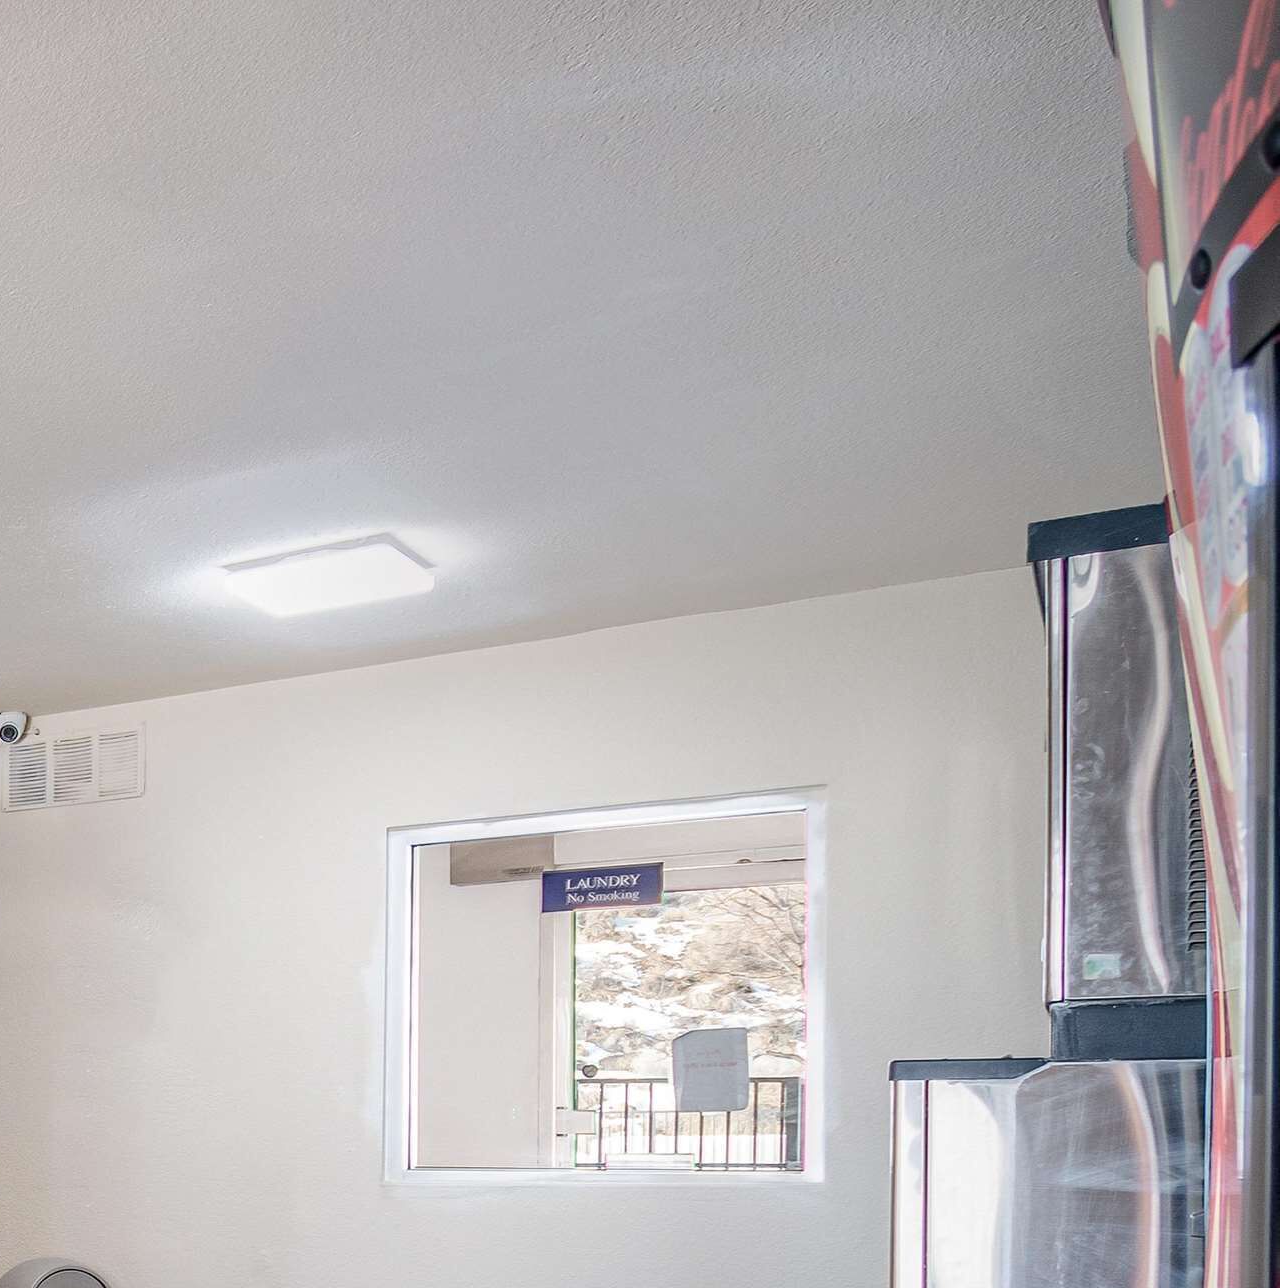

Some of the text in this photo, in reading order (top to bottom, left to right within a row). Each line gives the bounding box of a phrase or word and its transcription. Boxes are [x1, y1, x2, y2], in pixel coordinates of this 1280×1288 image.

[565, 874, 641, 891] LAUNDRY
[567, 890, 640, 905] No Smoking
